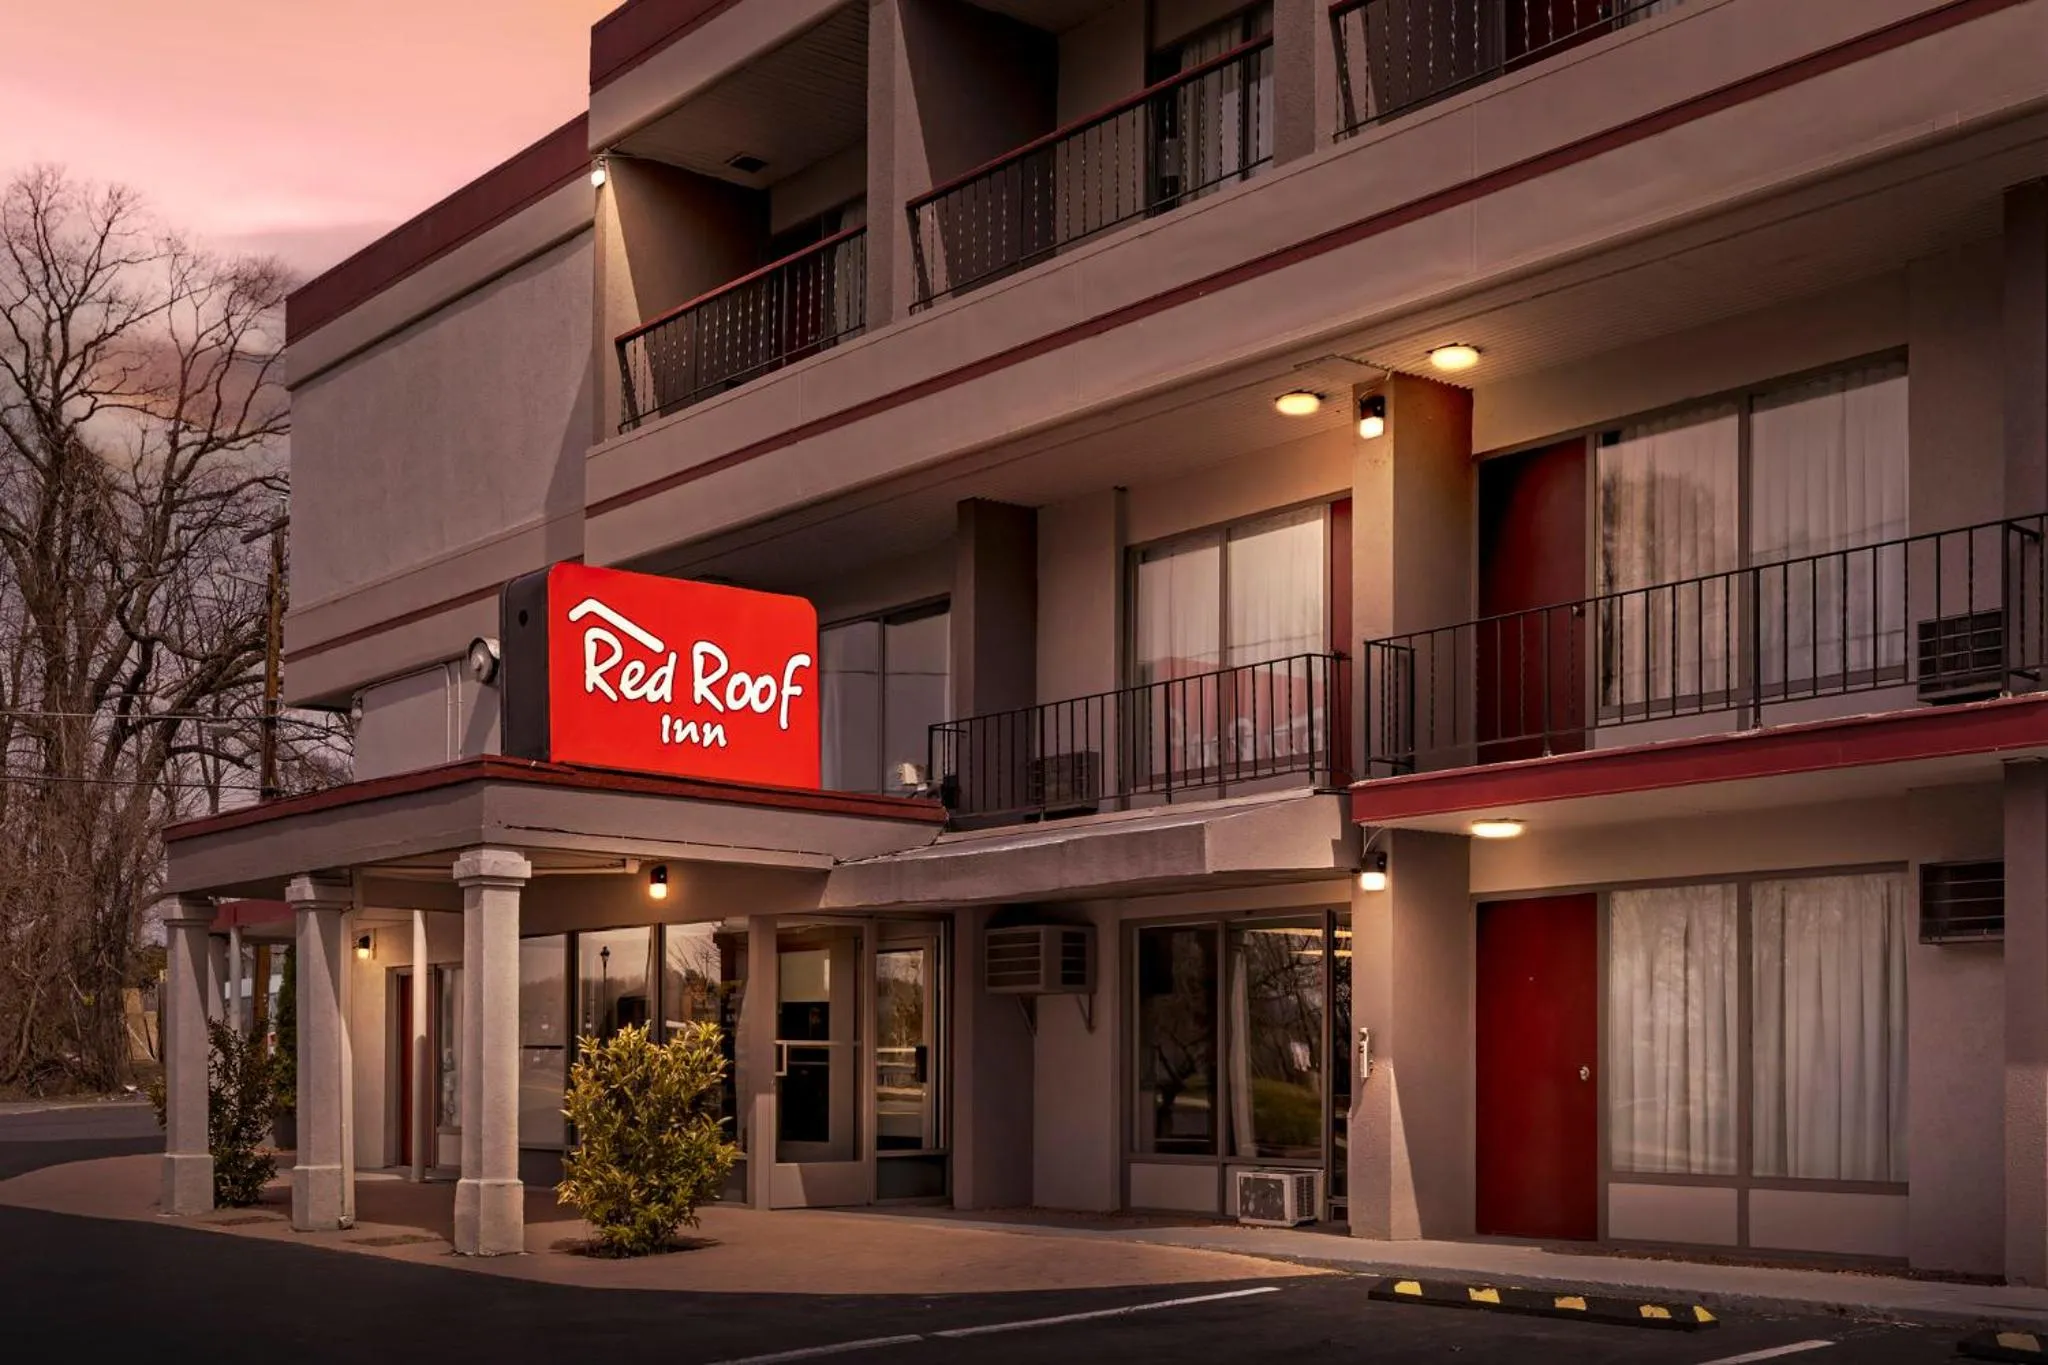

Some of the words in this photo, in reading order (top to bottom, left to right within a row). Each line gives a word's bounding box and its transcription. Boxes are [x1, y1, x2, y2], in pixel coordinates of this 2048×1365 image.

[584, 626, 677, 703] Red
[692, 641, 811, 730] Roof
[661, 714, 728, 748] Inn
